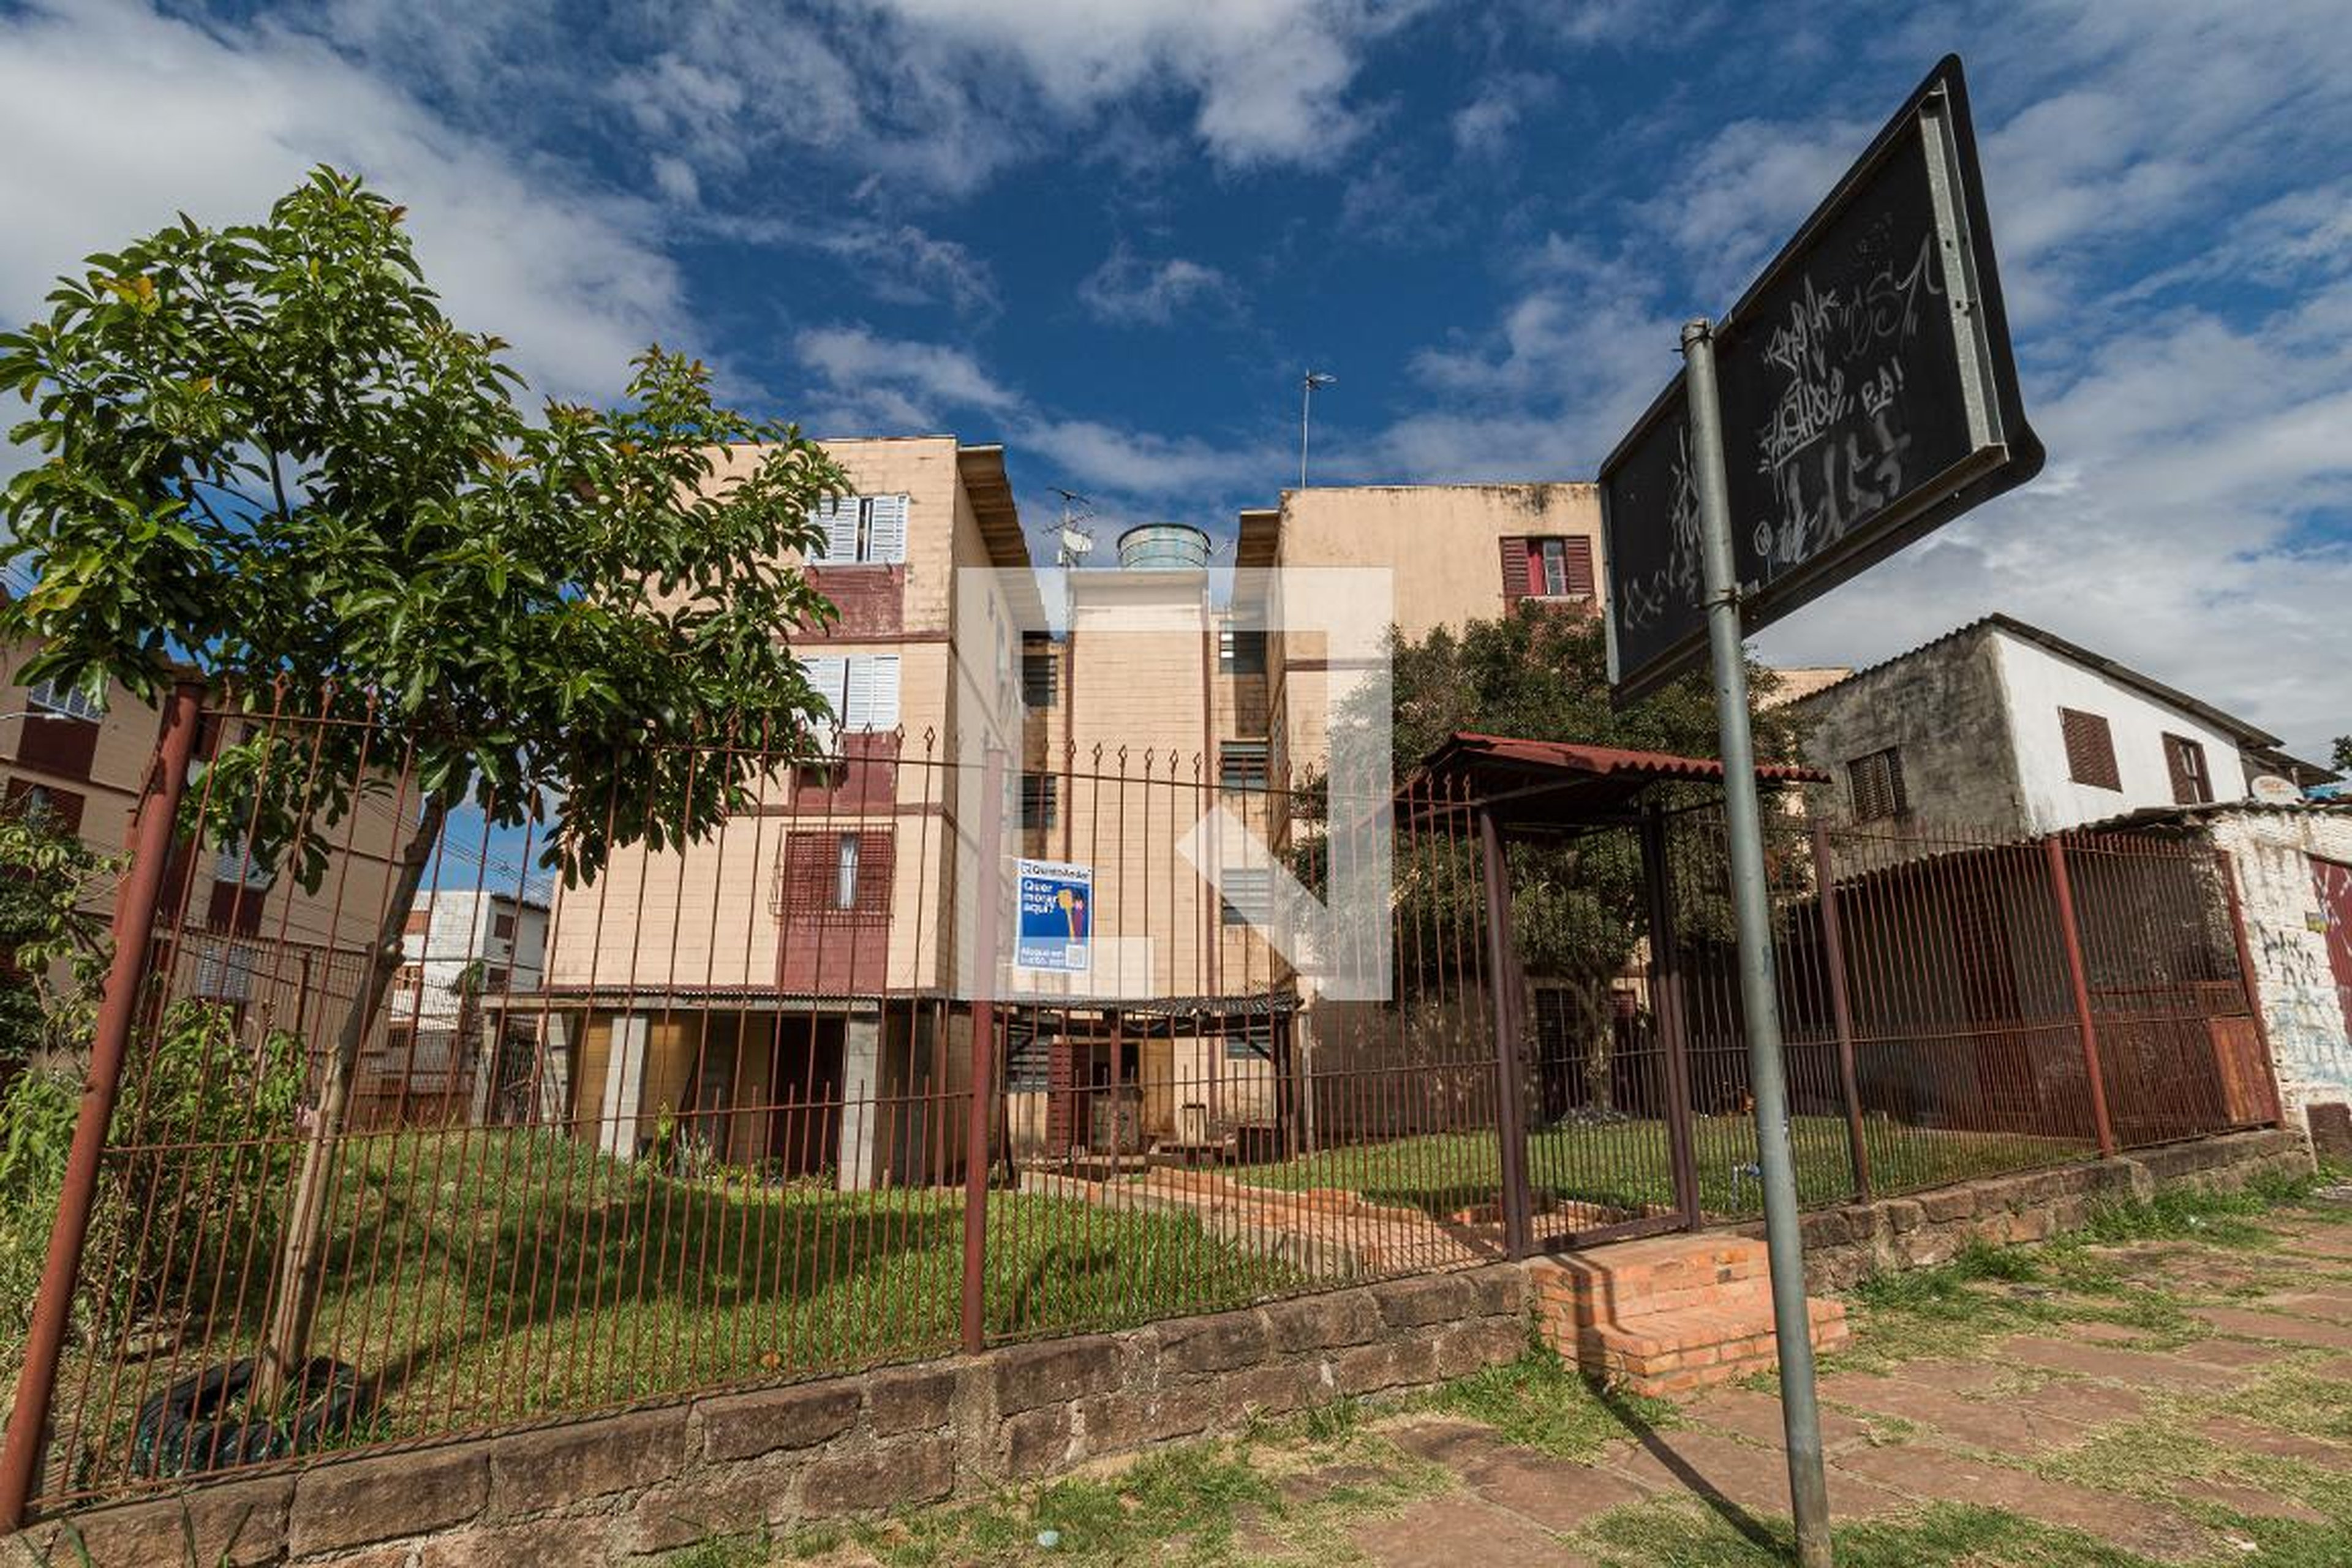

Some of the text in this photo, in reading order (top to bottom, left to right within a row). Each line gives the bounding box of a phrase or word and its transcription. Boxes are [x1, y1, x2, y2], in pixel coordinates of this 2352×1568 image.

[1024, 880, 1053, 892] Quer
[1023, 894, 1057, 903] morar
[1023, 902, 1054, 915] aqui?
